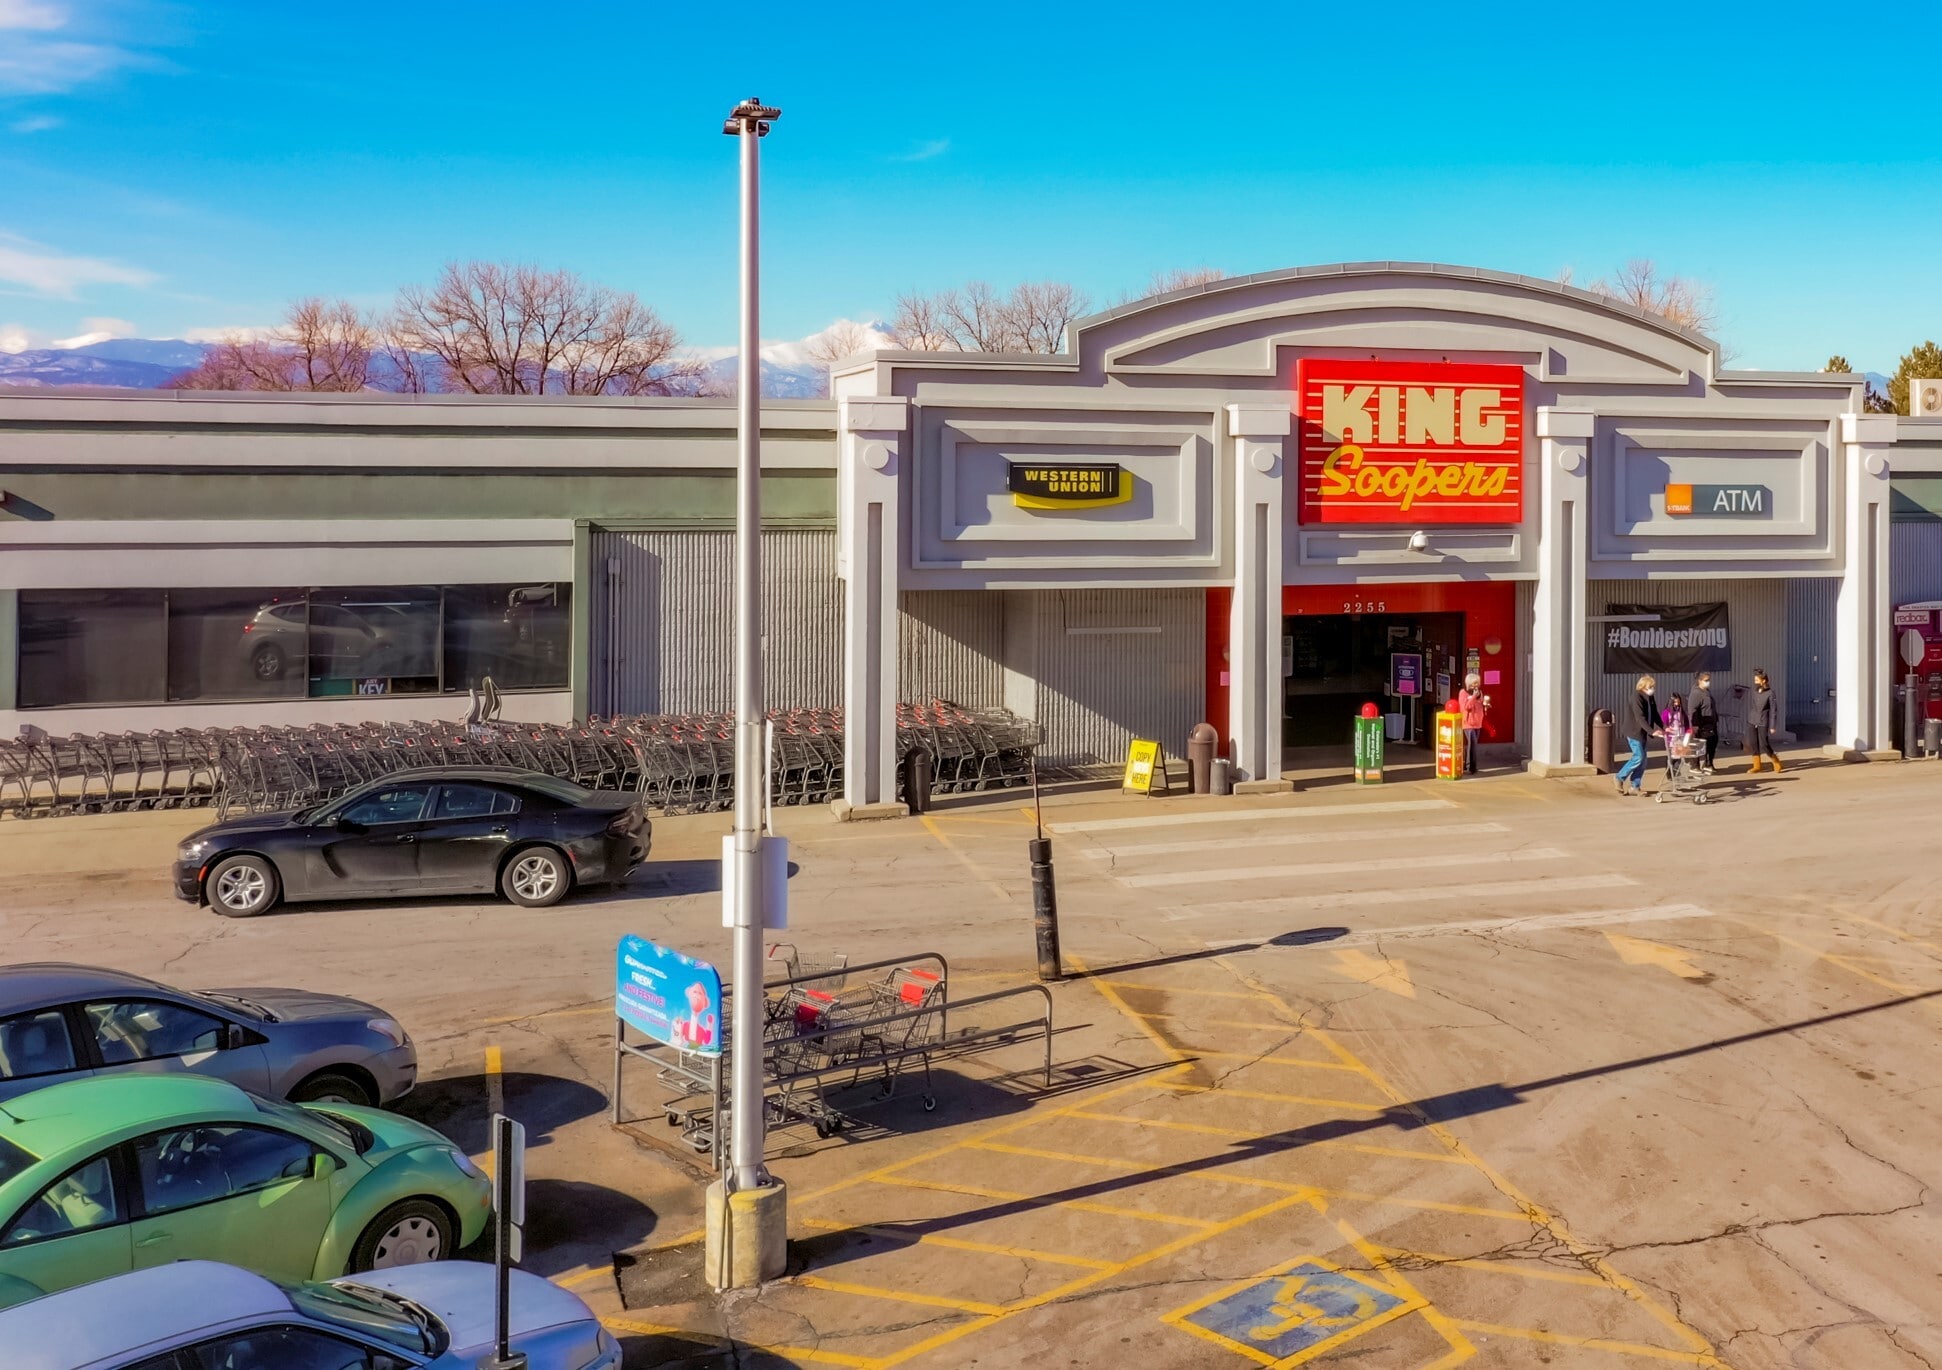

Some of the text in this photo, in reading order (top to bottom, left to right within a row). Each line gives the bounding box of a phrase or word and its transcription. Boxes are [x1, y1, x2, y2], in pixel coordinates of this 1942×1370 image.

[1322, 385, 1506, 446] KING
[1024, 470, 1101, 482] WESTERN
[1317, 444, 1509, 511] Soopers
[1048, 481, 1101, 493] UNION
[1712, 490, 1763, 512] ATM
[1343, 601, 1386, 613] 2255
[1607, 626, 1727, 649] #Boulderstrong
[358, 683, 385, 696] KEY
